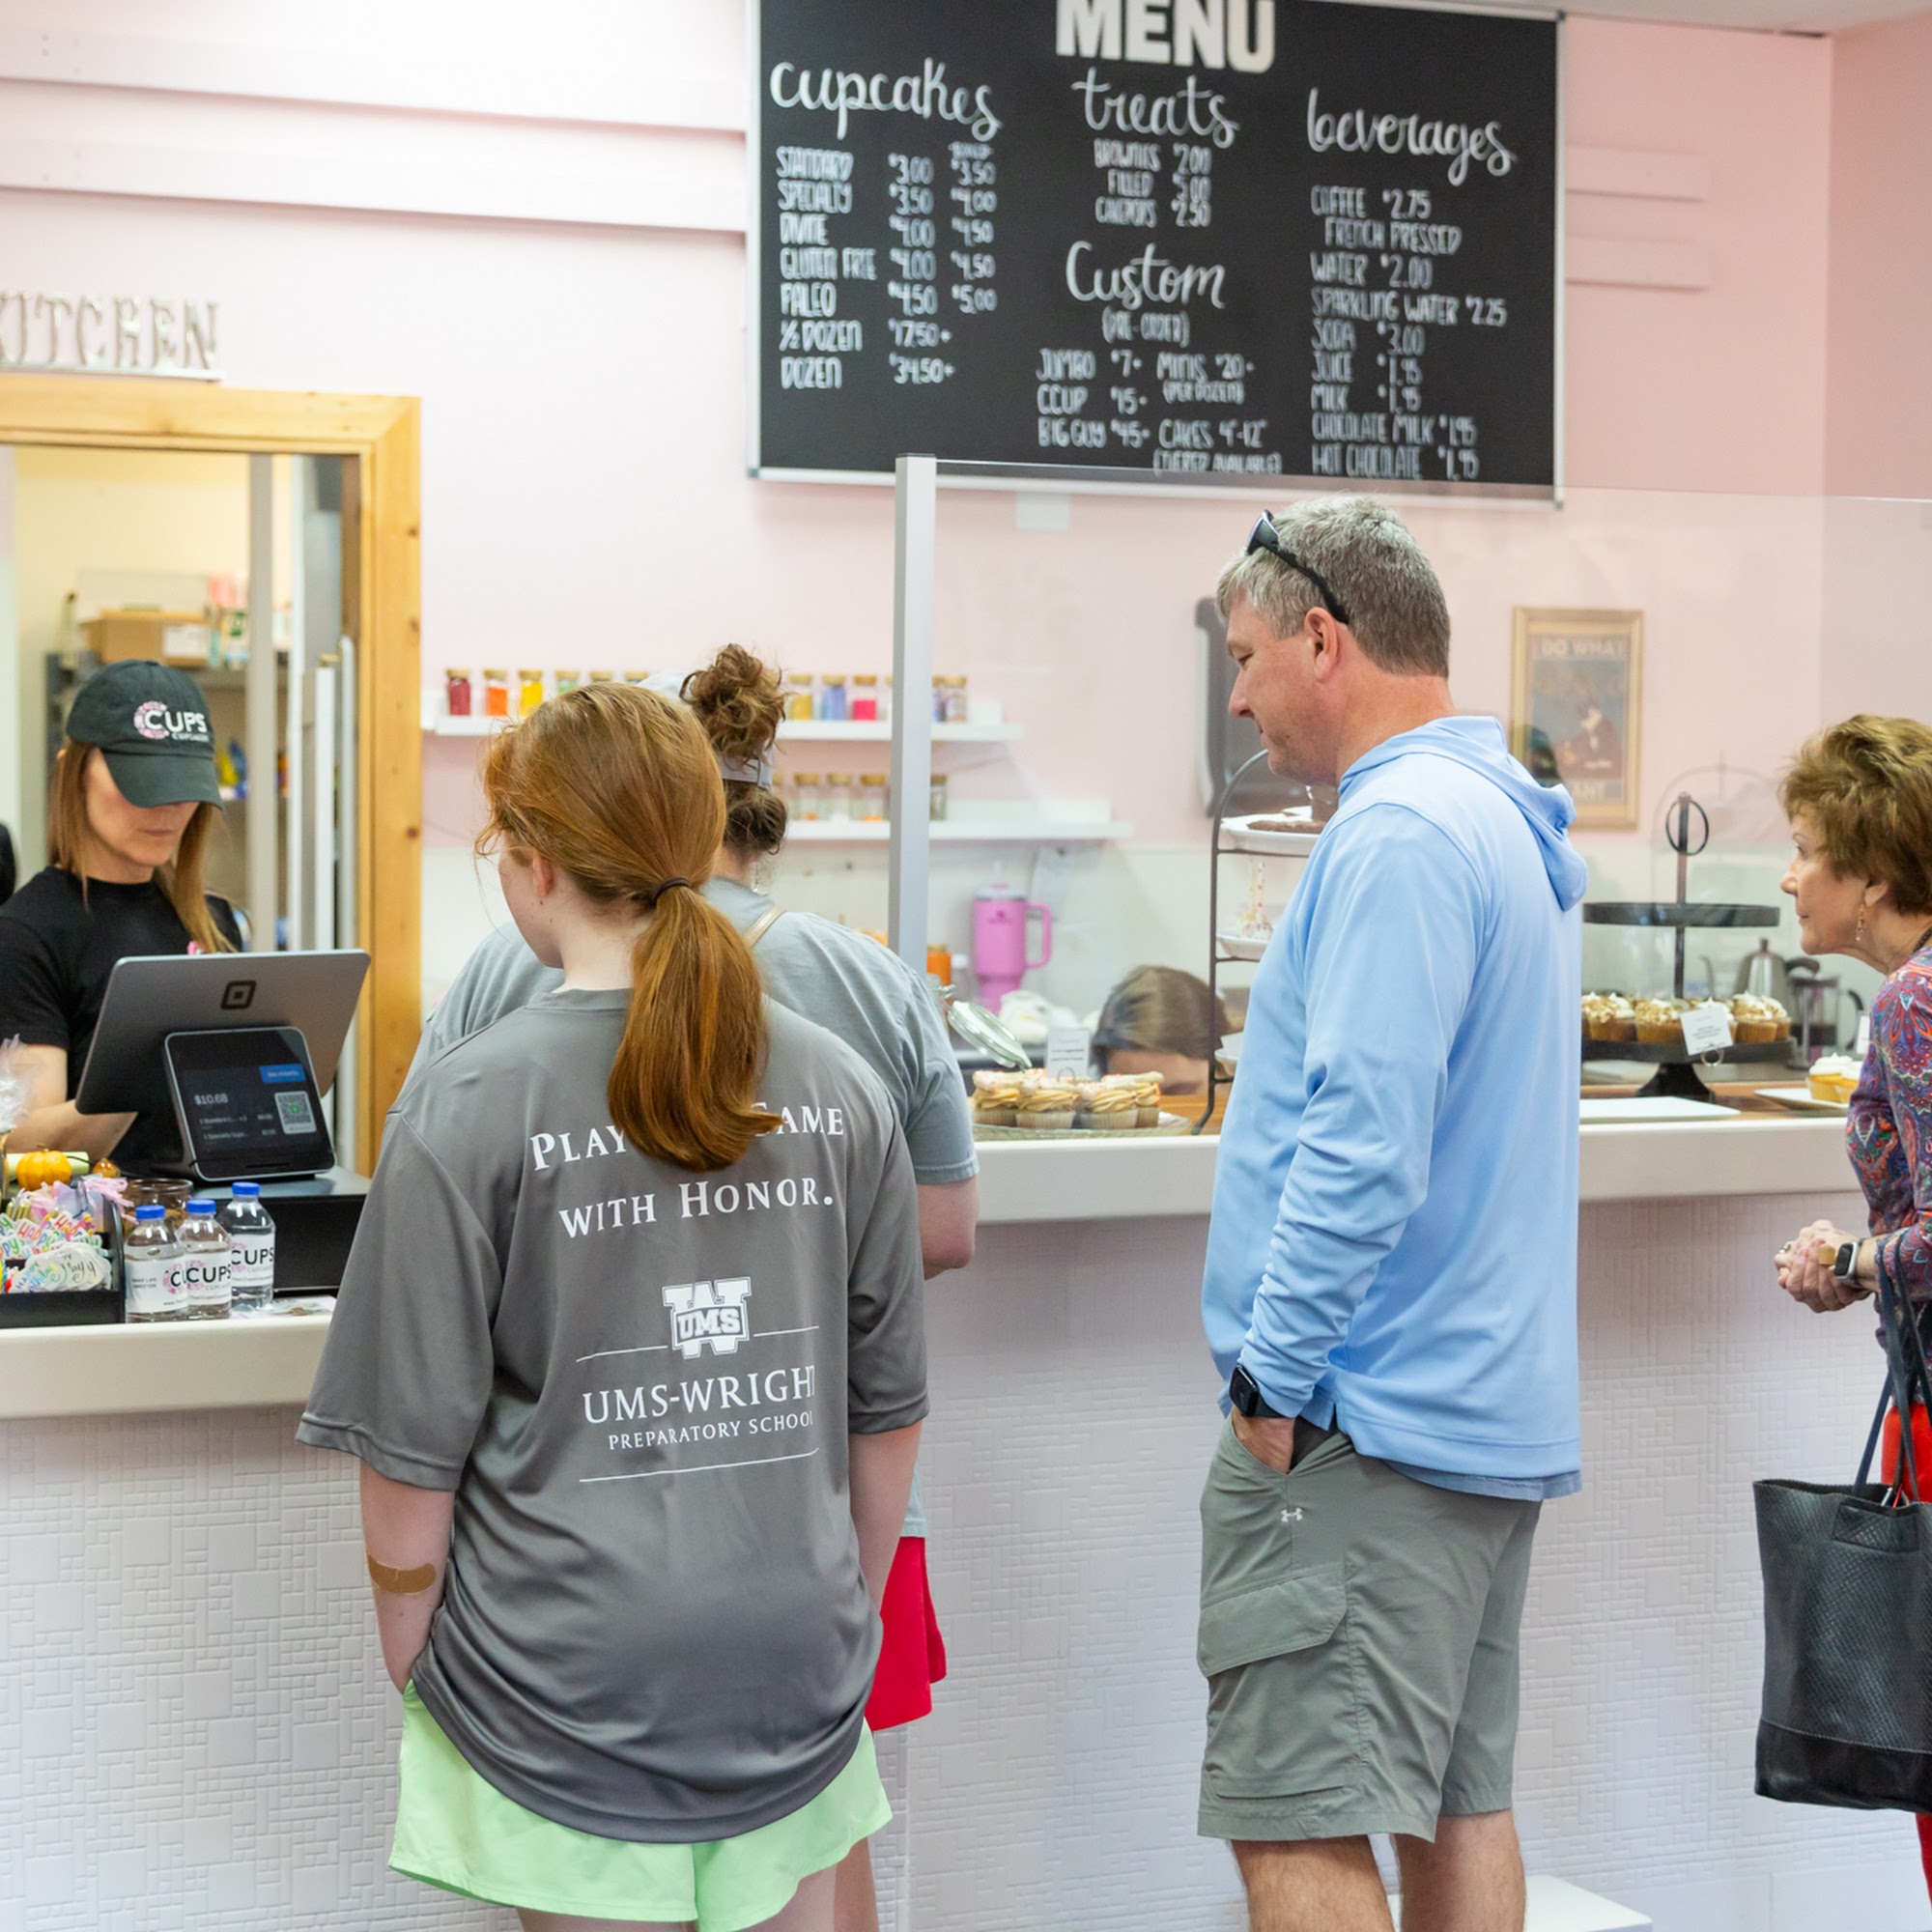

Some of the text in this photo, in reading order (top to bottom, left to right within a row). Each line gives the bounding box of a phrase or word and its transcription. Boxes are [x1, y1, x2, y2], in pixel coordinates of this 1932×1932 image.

[1056, 0, 1275, 73] MENU
[770, 57, 1002, 140] cupcakes
[1070, 67, 1240, 148] treats
[1307, 87, 1520, 186] beverages
[1311, 182, 1367, 218] COFFEE
[1390, 220, 1463, 255] PRESSED
[1065, 241, 1226, 311] Custom
[1310, 250, 1369, 287] WATER
[781, 281, 837, 317] PALEO
[1311, 286, 1401, 321] SPARKLING
[1404, 293, 1460, 326] WATER
[0, 294, 217, 369] ITCHEN
[802, 320, 863, 352] DOZEN
[1311, 317, 1356, 352] SODA
[781, 356, 842, 388] DOZEN
[1036, 348, 1096, 382] JUMBO
[1311, 351, 1353, 383] JUICE
[1311, 384, 1350, 412] MILK
[1159, 418, 1214, 449] CAKES
[1392, 414, 1436, 446] MILK
[144, 710, 208, 733] CUPS
[530, 1102, 845, 1171] PLAY AME
[559, 1180, 834, 1238] WITH HONOR.
[677, 1307, 742, 1340] UMS
[609, 1421, 741, 1450] PREPARATORY
